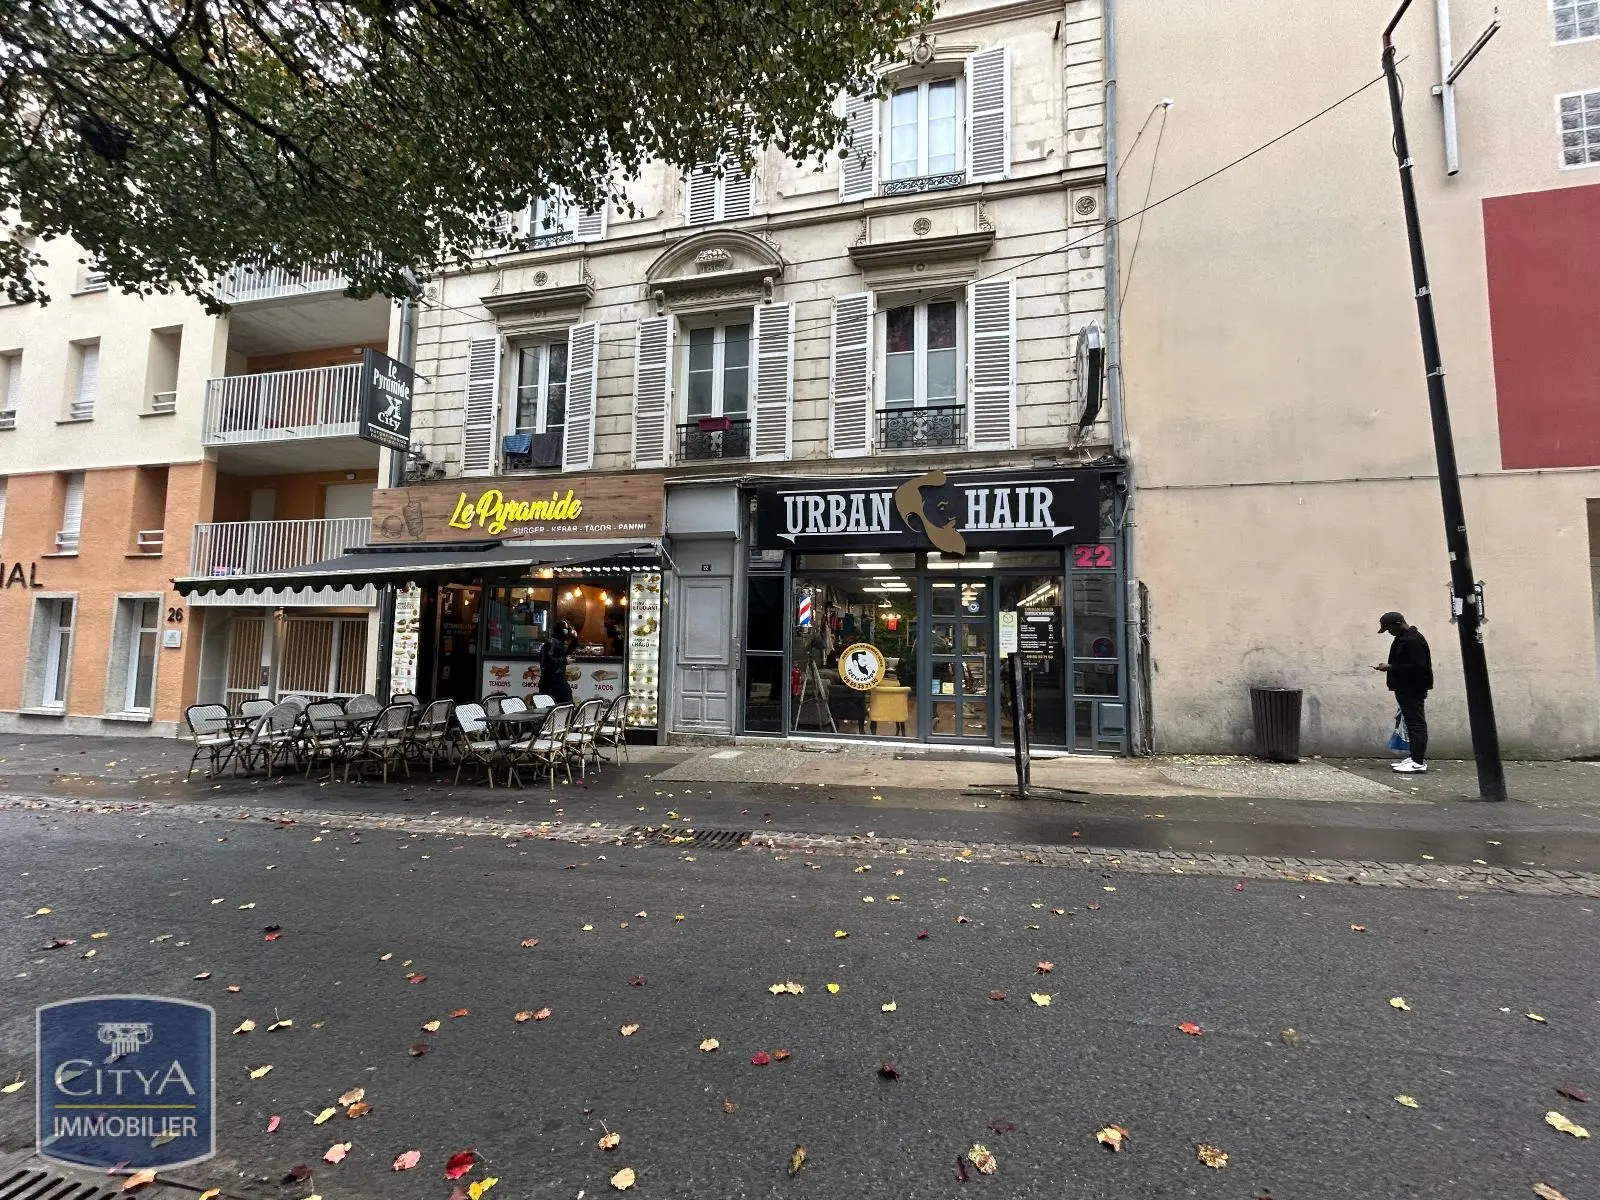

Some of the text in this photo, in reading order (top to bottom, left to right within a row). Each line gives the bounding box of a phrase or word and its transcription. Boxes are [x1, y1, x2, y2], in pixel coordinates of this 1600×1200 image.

[372, 367, 410, 400] Pyramide
[377, 411, 401, 431] City
[448, 489, 582, 535] Le Pyramide
[783, 486, 1055, 534] URBAN HAIR
[513, 523, 646, 534] BURGER KEBAB TACOS PANINI
[1073, 545, 1114, 568] 22
[167, 607, 184, 623] 26
